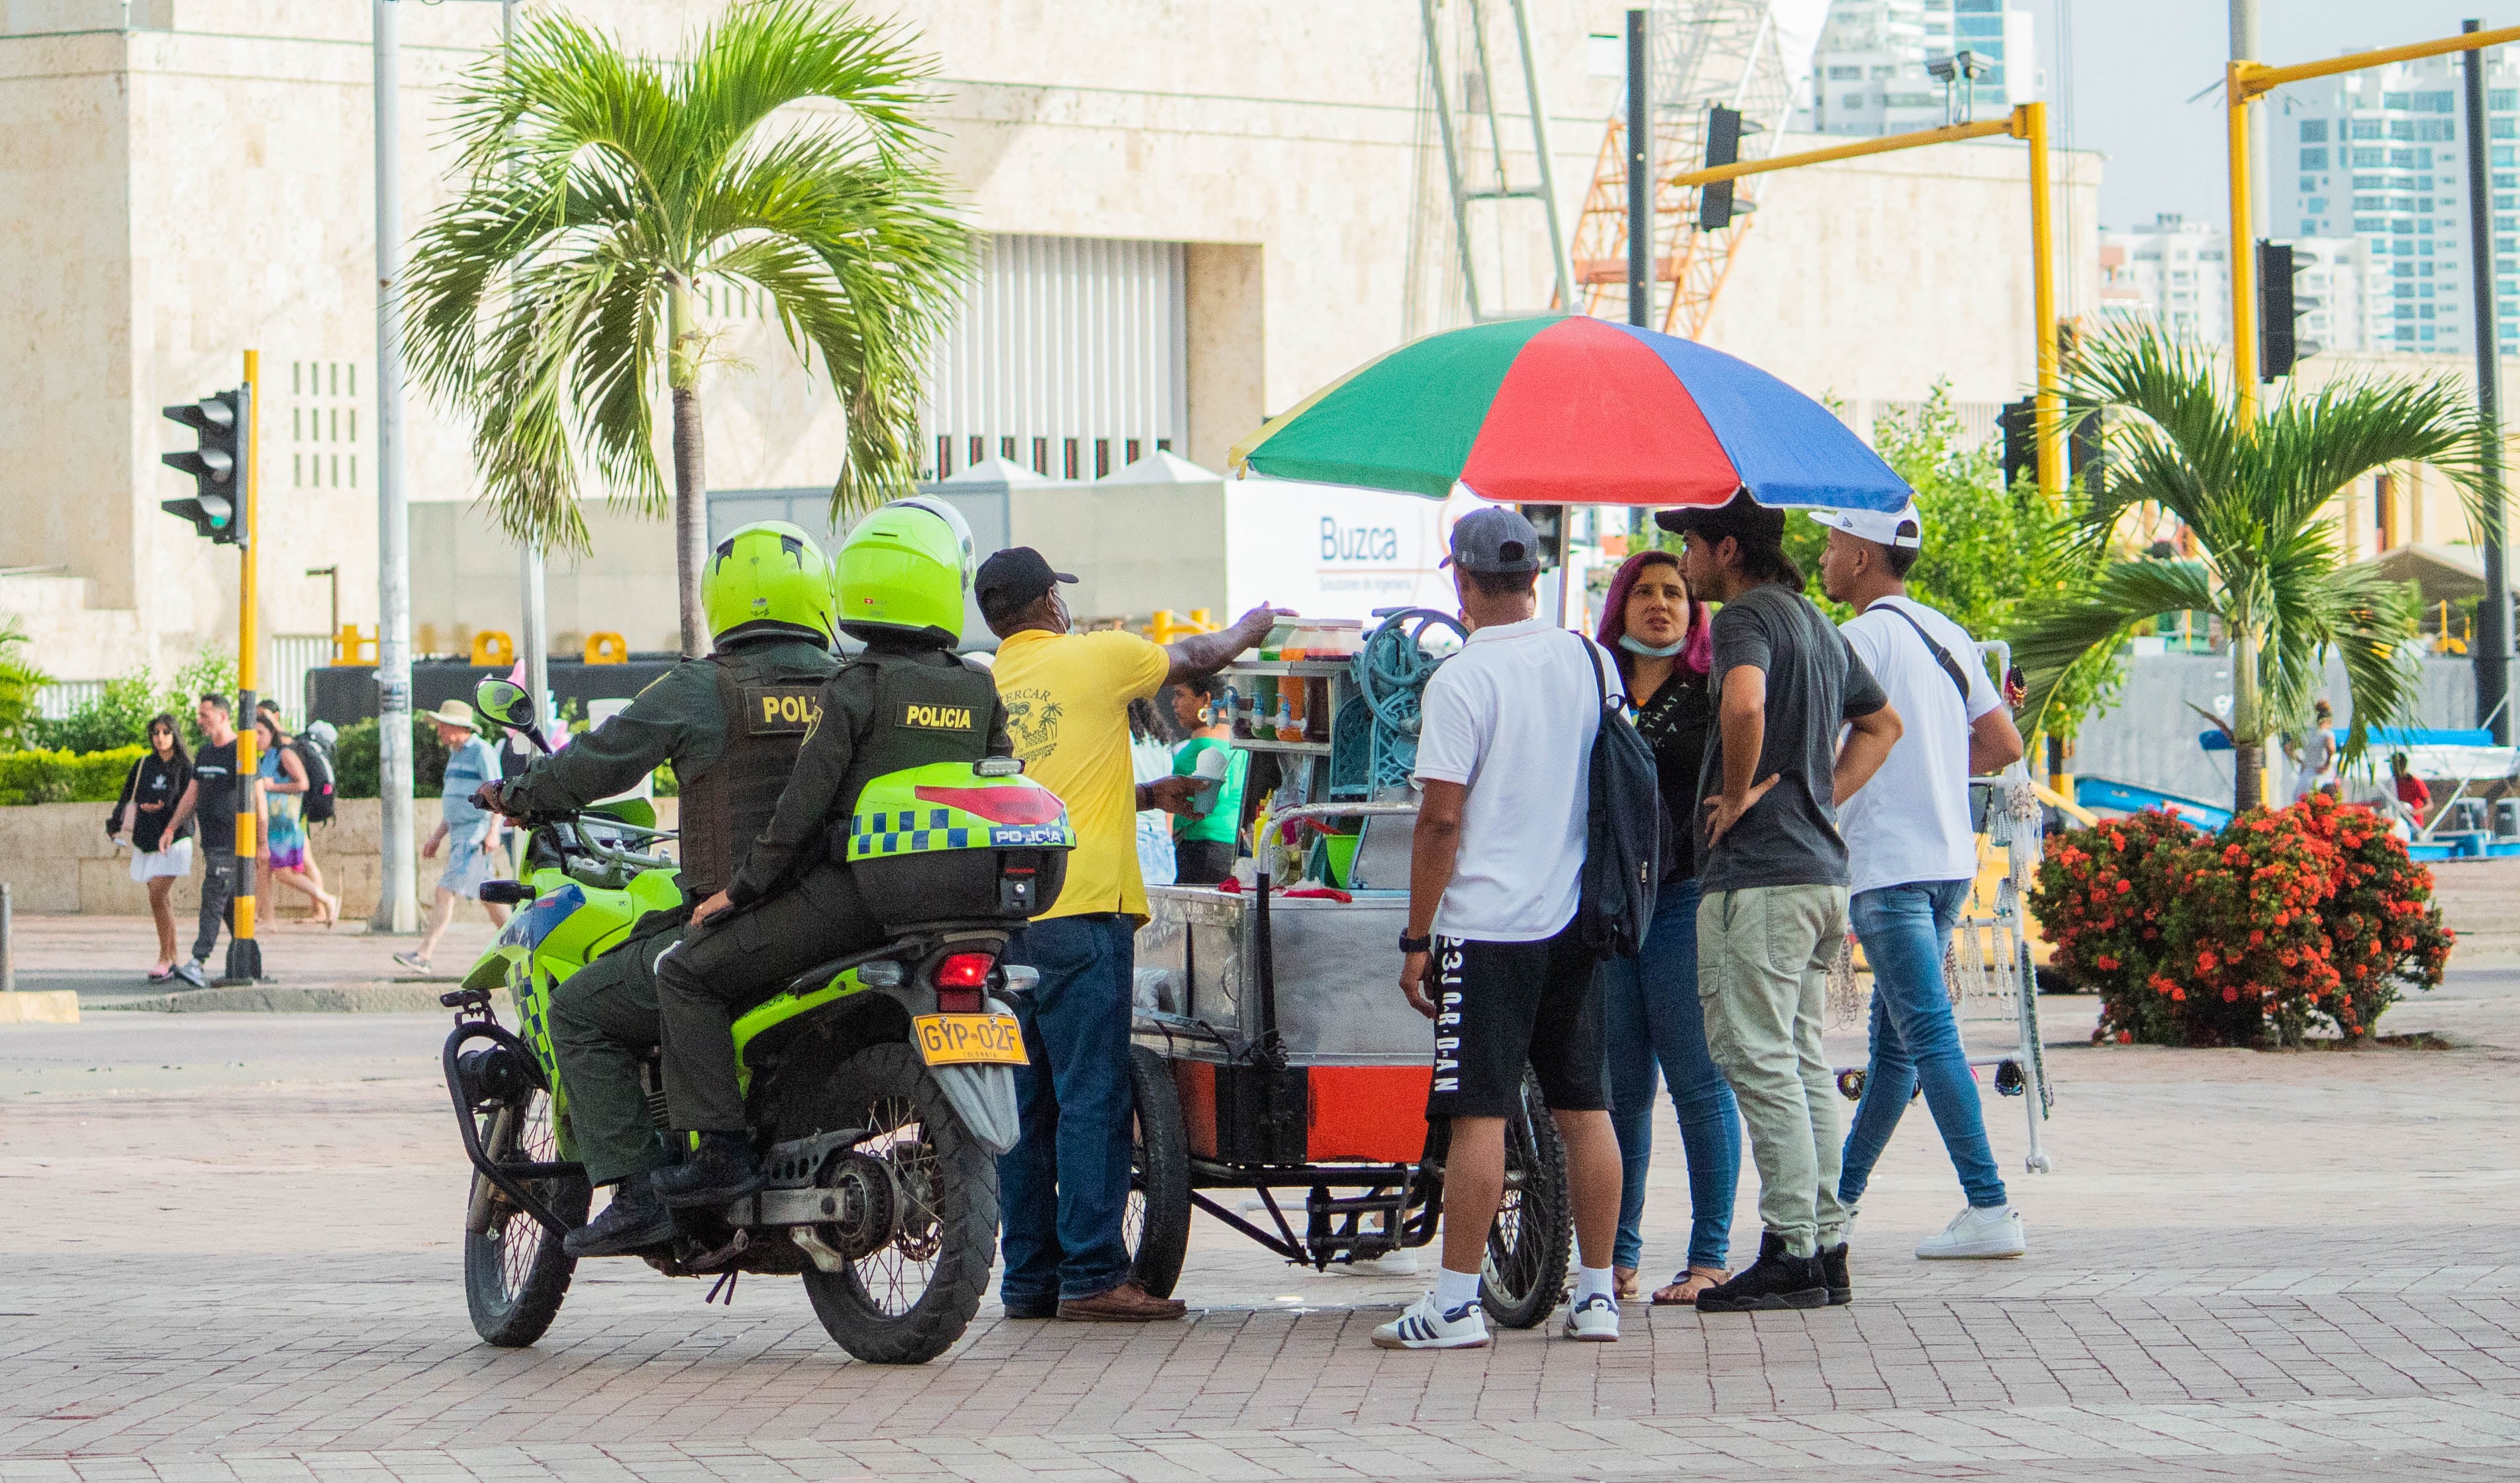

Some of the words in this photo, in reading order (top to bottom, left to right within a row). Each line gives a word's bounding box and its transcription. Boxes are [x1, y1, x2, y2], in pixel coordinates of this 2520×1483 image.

[1320, 516, 1398, 561] Buzca
[1000, 688, 1051, 702] ERCAR
[762, 696, 816, 724] POL
[906, 705, 971, 728] POLICIA
